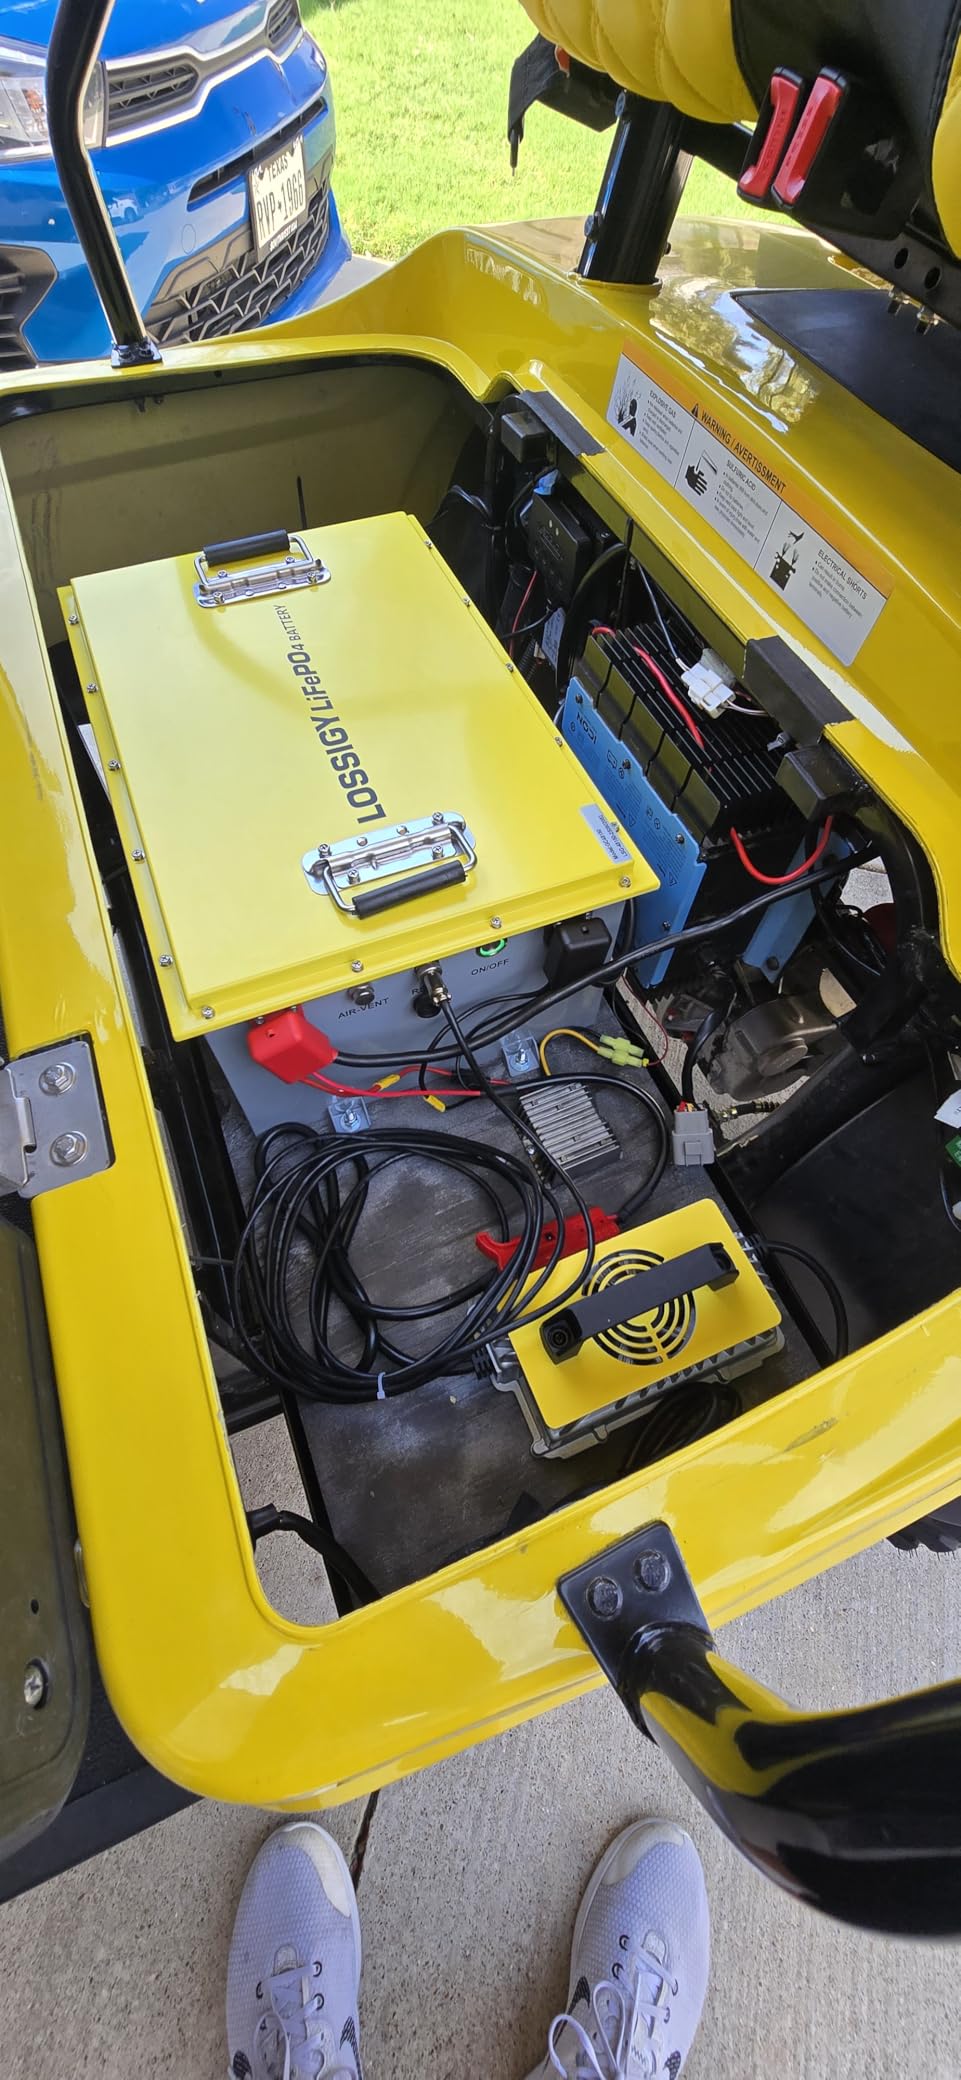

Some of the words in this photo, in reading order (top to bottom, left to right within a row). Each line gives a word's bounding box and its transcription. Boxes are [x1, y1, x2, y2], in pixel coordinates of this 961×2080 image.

[268, 156, 289, 182] TEXAS
[649, 390, 669, 412] EXPLOSIVE
[701, 411, 732, 444] WARNING
[734, 442, 787, 494] AVERTISSMENT
[727, 459, 747, 484] SULFURIC
[744, 477, 756, 491] ACID
[818, 549, 847, 581] ELECTRICAL
[846, 577, 868, 600] SHORTS
[273, 604, 302, 641] BATTERY
[576, 711, 598, 745] ICON
[310, 716, 387, 824] LOSSIGY
[471, 958, 510, 976] ON/OFF
[338, 997, 390, 1020] AIR-VENT
